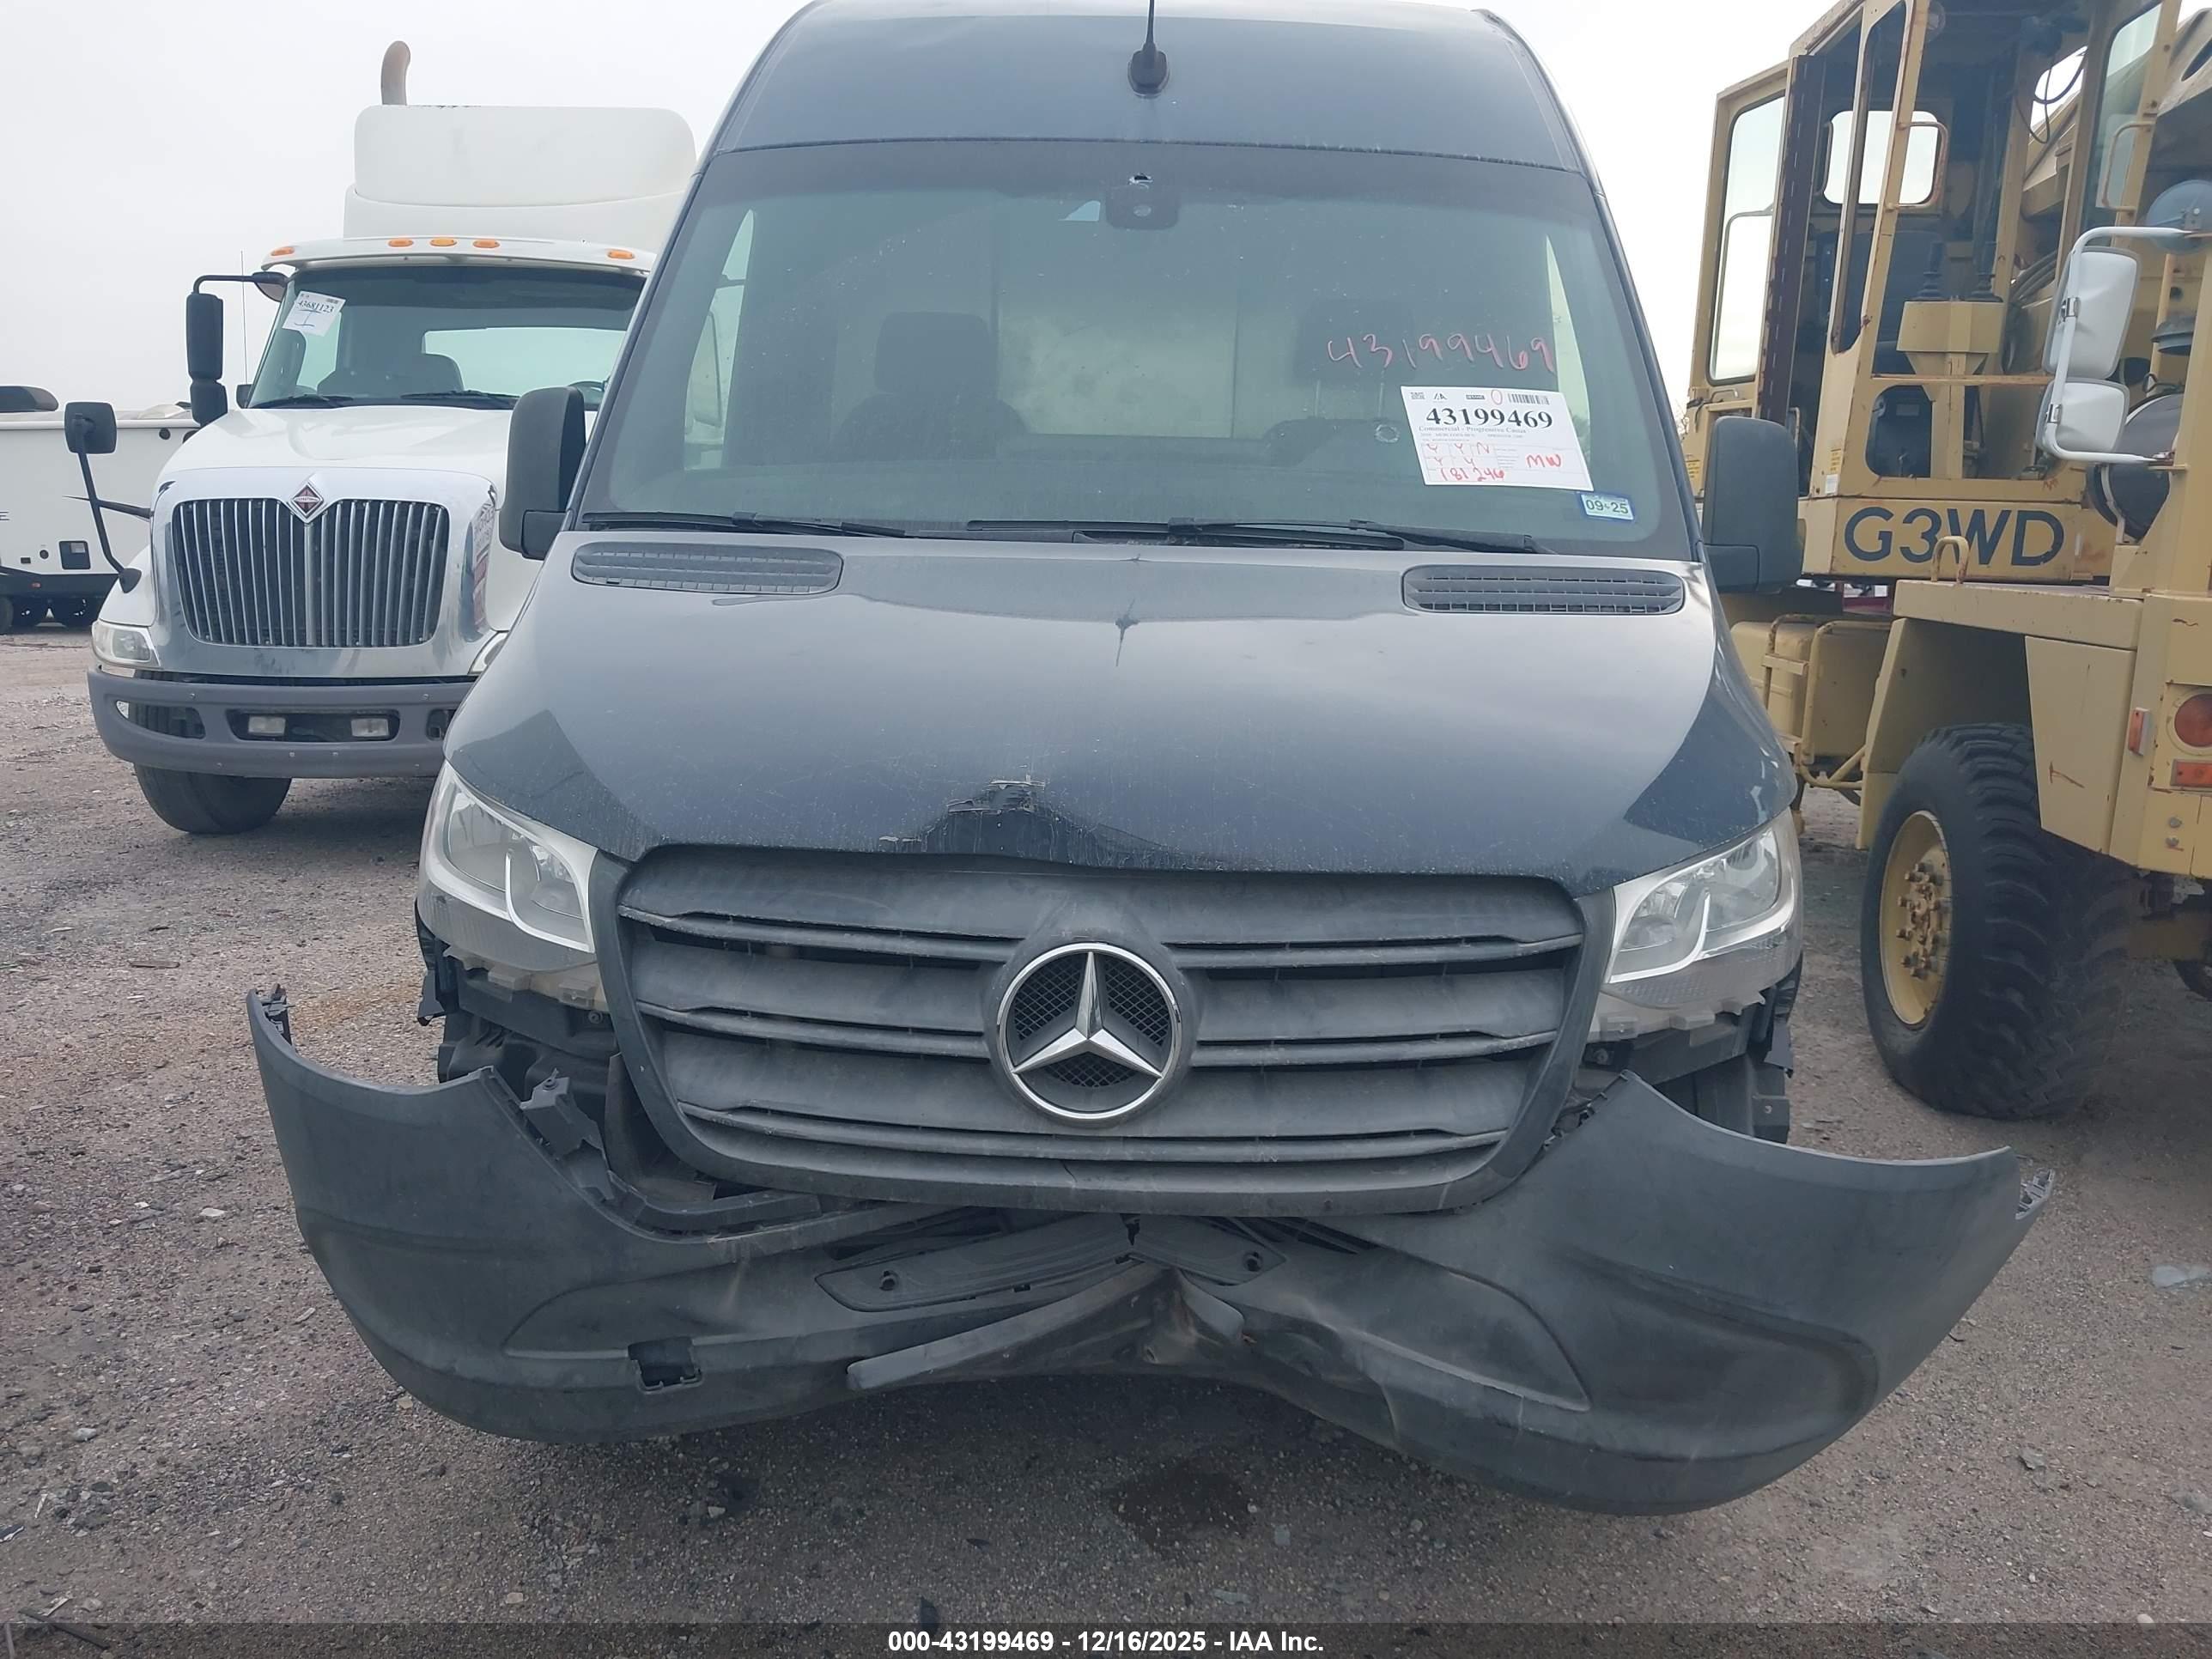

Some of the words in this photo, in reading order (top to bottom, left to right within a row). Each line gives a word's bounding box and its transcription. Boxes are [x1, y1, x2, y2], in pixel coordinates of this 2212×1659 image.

[1327, 332, 1555, 374] 43199469
[1425, 407, 1553, 429] 43199469
[1844, 506, 2065, 567] G3WD
